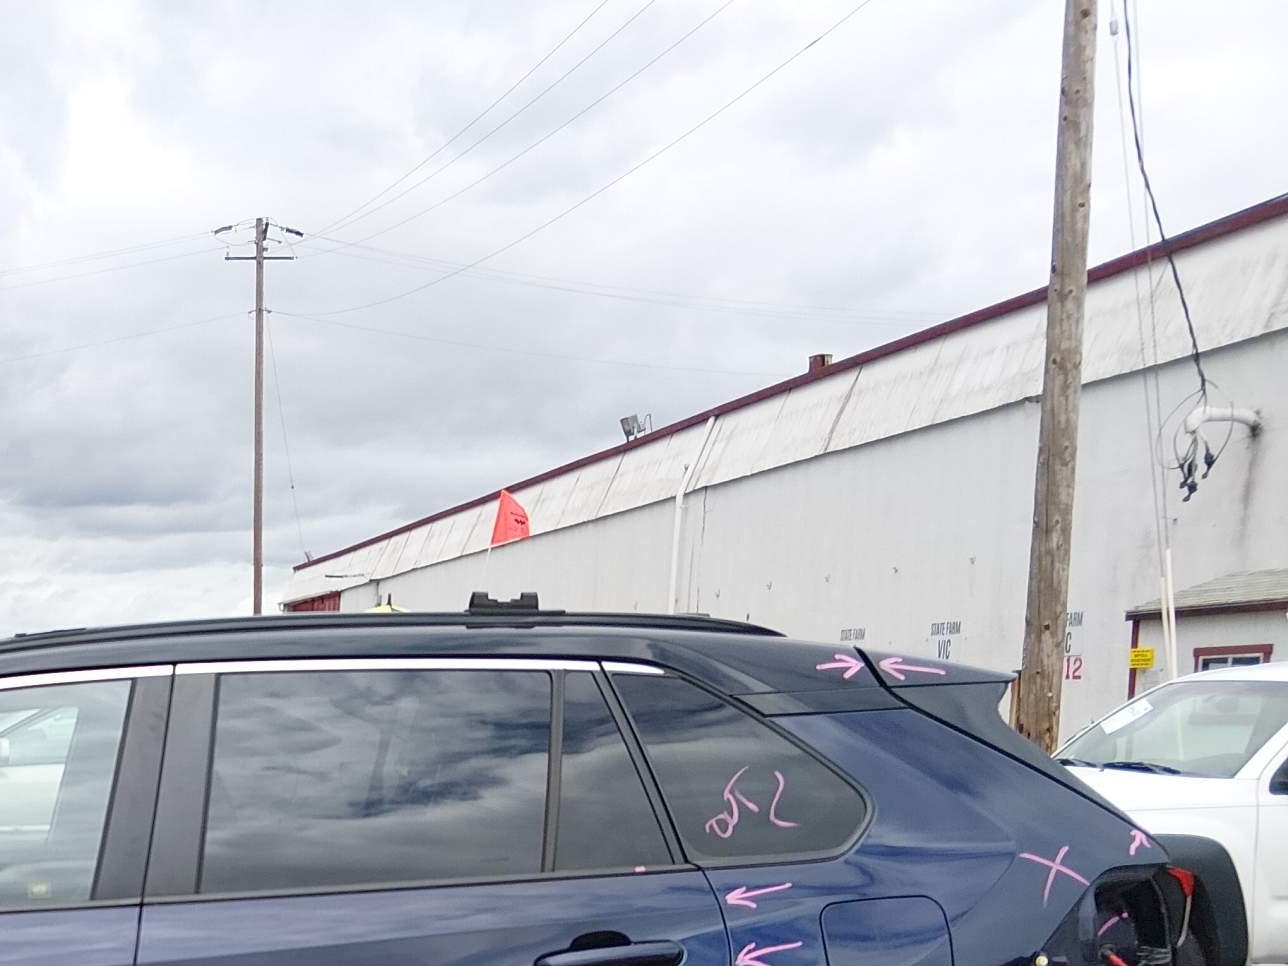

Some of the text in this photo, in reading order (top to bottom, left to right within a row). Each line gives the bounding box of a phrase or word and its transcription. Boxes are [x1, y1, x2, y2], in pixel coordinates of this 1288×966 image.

[931, 621, 961, 636] STATE FARM
[937, 639, 951, 660] VIC
[1065, 656, 1082, 680] 12
